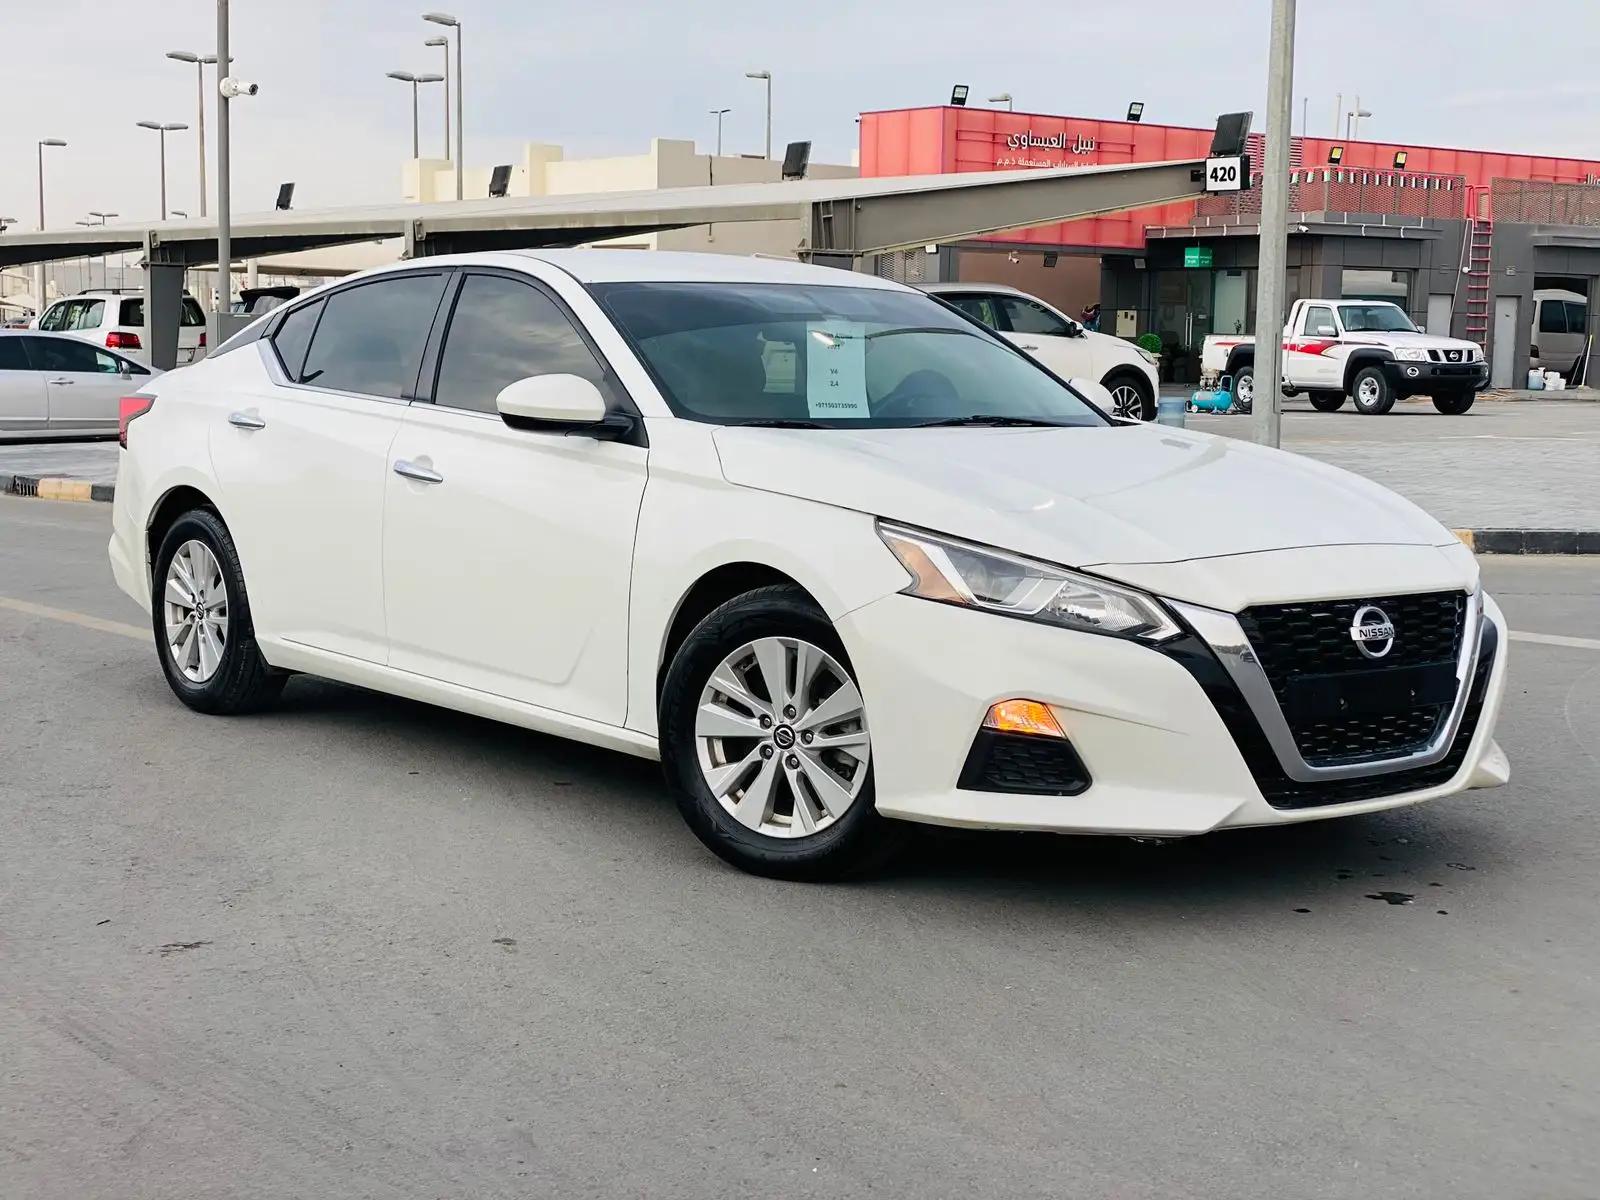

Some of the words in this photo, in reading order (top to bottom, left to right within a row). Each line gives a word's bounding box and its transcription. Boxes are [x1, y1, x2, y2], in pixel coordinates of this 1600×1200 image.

[1007, 130, 1066, 151] العيساوي
[1072, 134, 1095, 154] نبيل
[1209, 166, 1237, 183] 420
[1359, 627, 1394, 638] NISSAN
